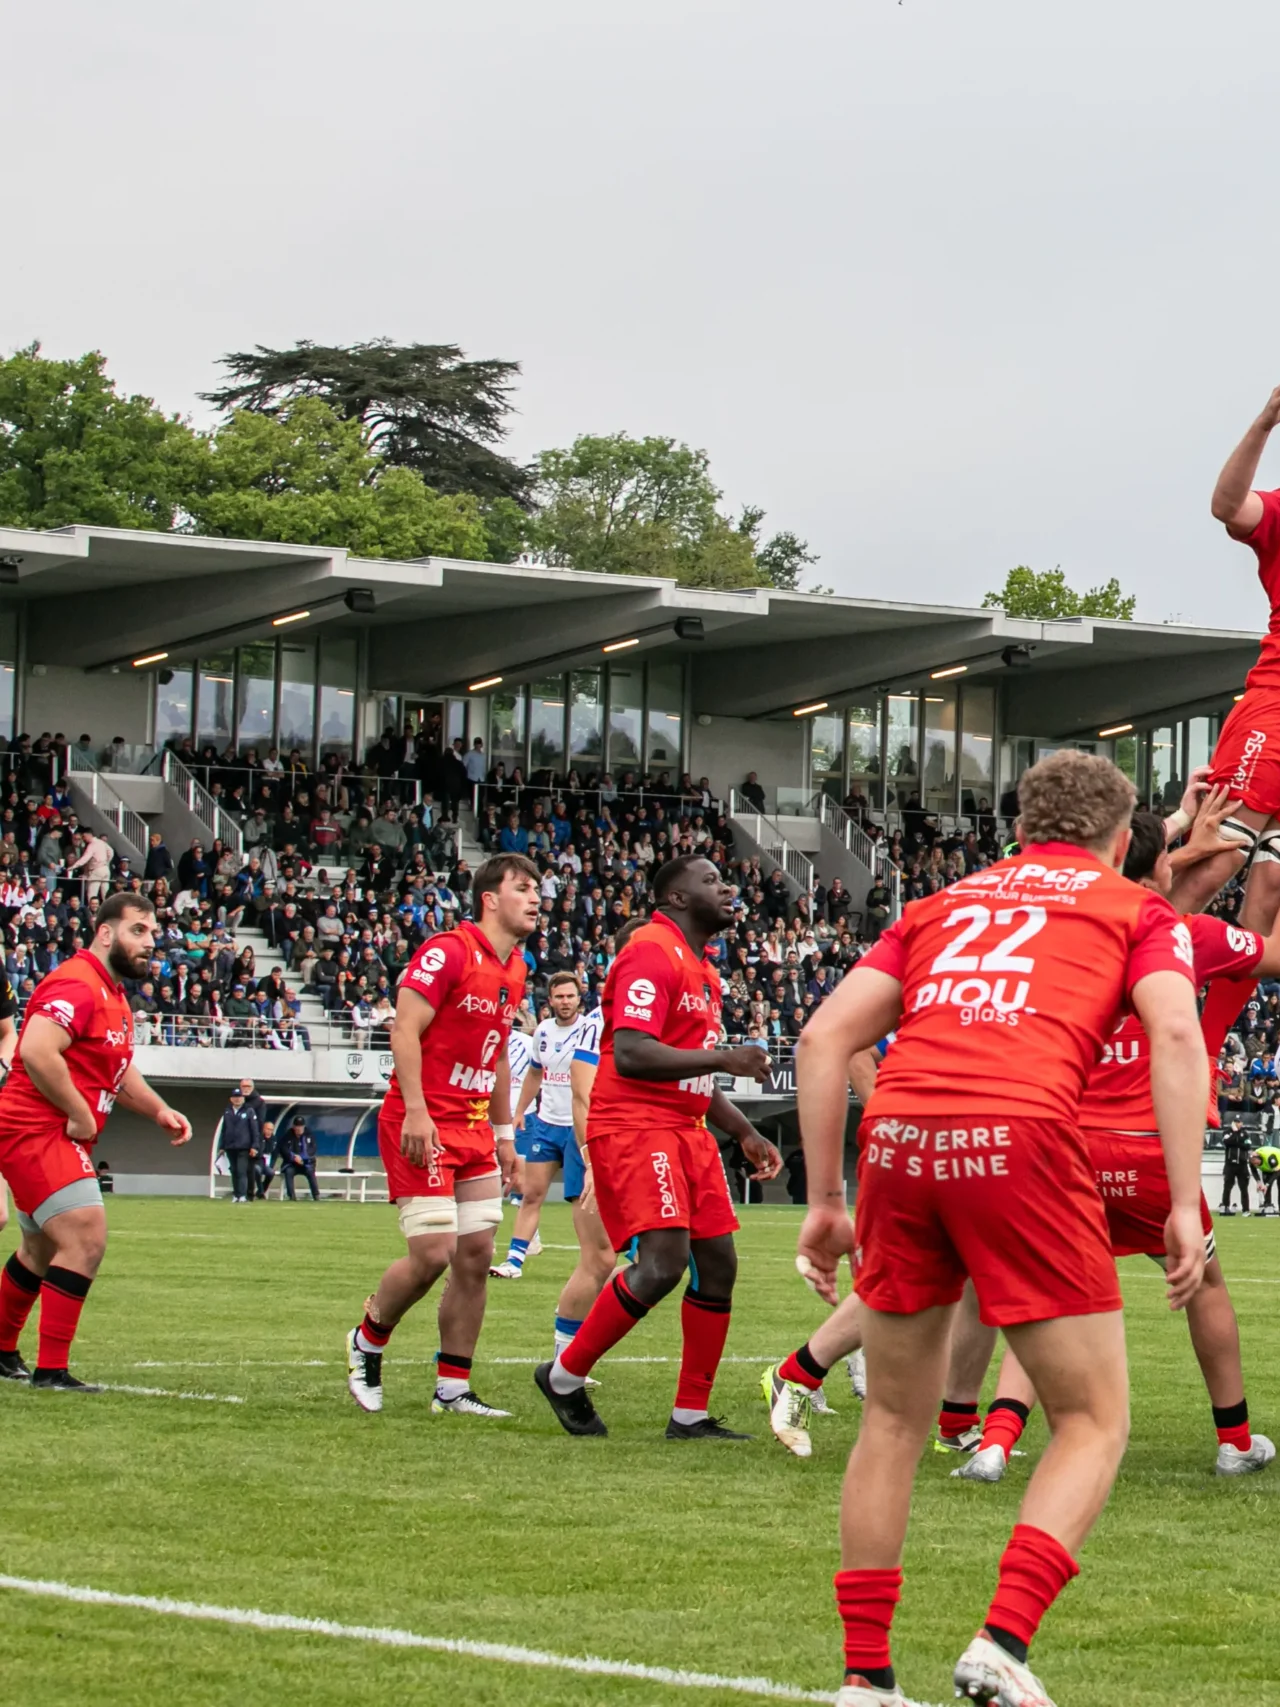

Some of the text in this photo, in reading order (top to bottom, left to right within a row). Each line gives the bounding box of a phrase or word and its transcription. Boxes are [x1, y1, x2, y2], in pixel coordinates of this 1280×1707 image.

[929, 904, 1048, 975] 22
[456, 993, 499, 1016] AGON
[624, 1005, 653, 1018] GLASS
[960, 1006, 1020, 1027] glass
[102, 1029, 125, 1047] AGO
[901, 1125, 1012, 1152] PIERRE
[867, 1143, 1010, 1181] DE SEINE
